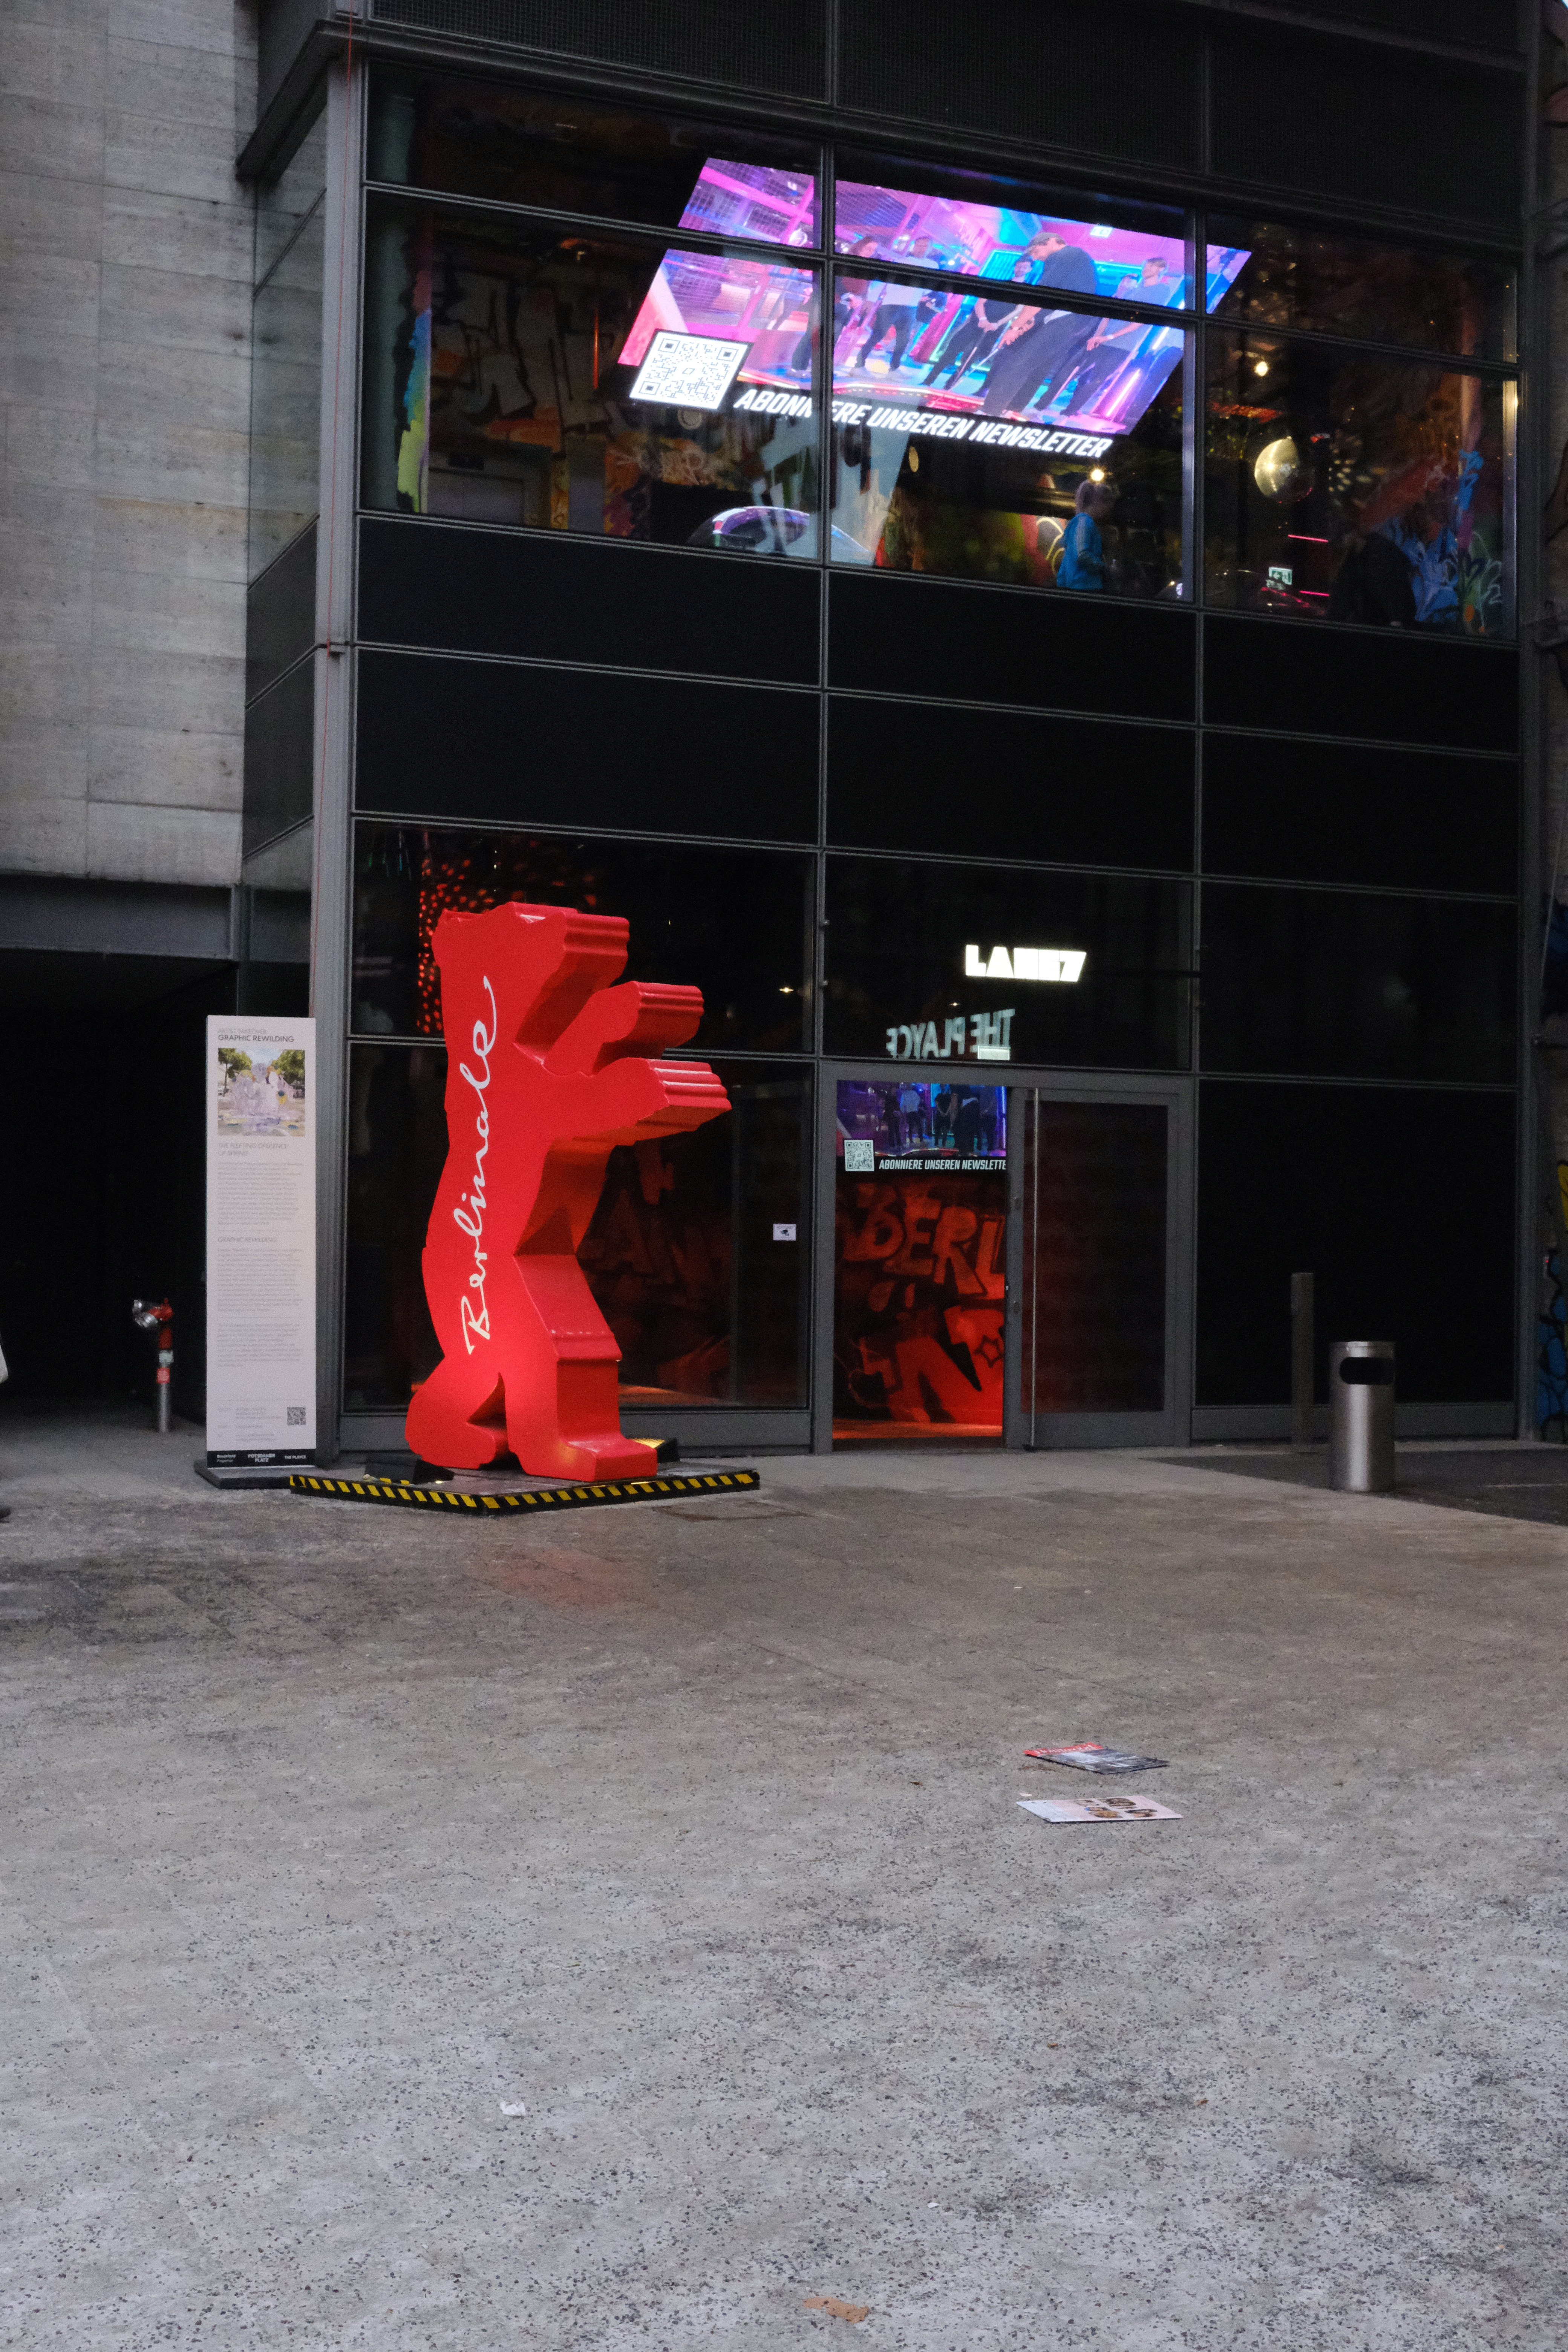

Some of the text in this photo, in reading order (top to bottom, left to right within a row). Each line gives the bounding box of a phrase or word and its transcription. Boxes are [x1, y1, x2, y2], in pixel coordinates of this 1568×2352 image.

[867, 405, 972, 439] UNSEREN
[969, 421, 1113, 458] NEWSLETTER
[454, 975, 497, 1355] Berlinale
[879, 1159, 923, 1170] ABONNIERE
[924, 1159, 961, 1170] UNSEREN
